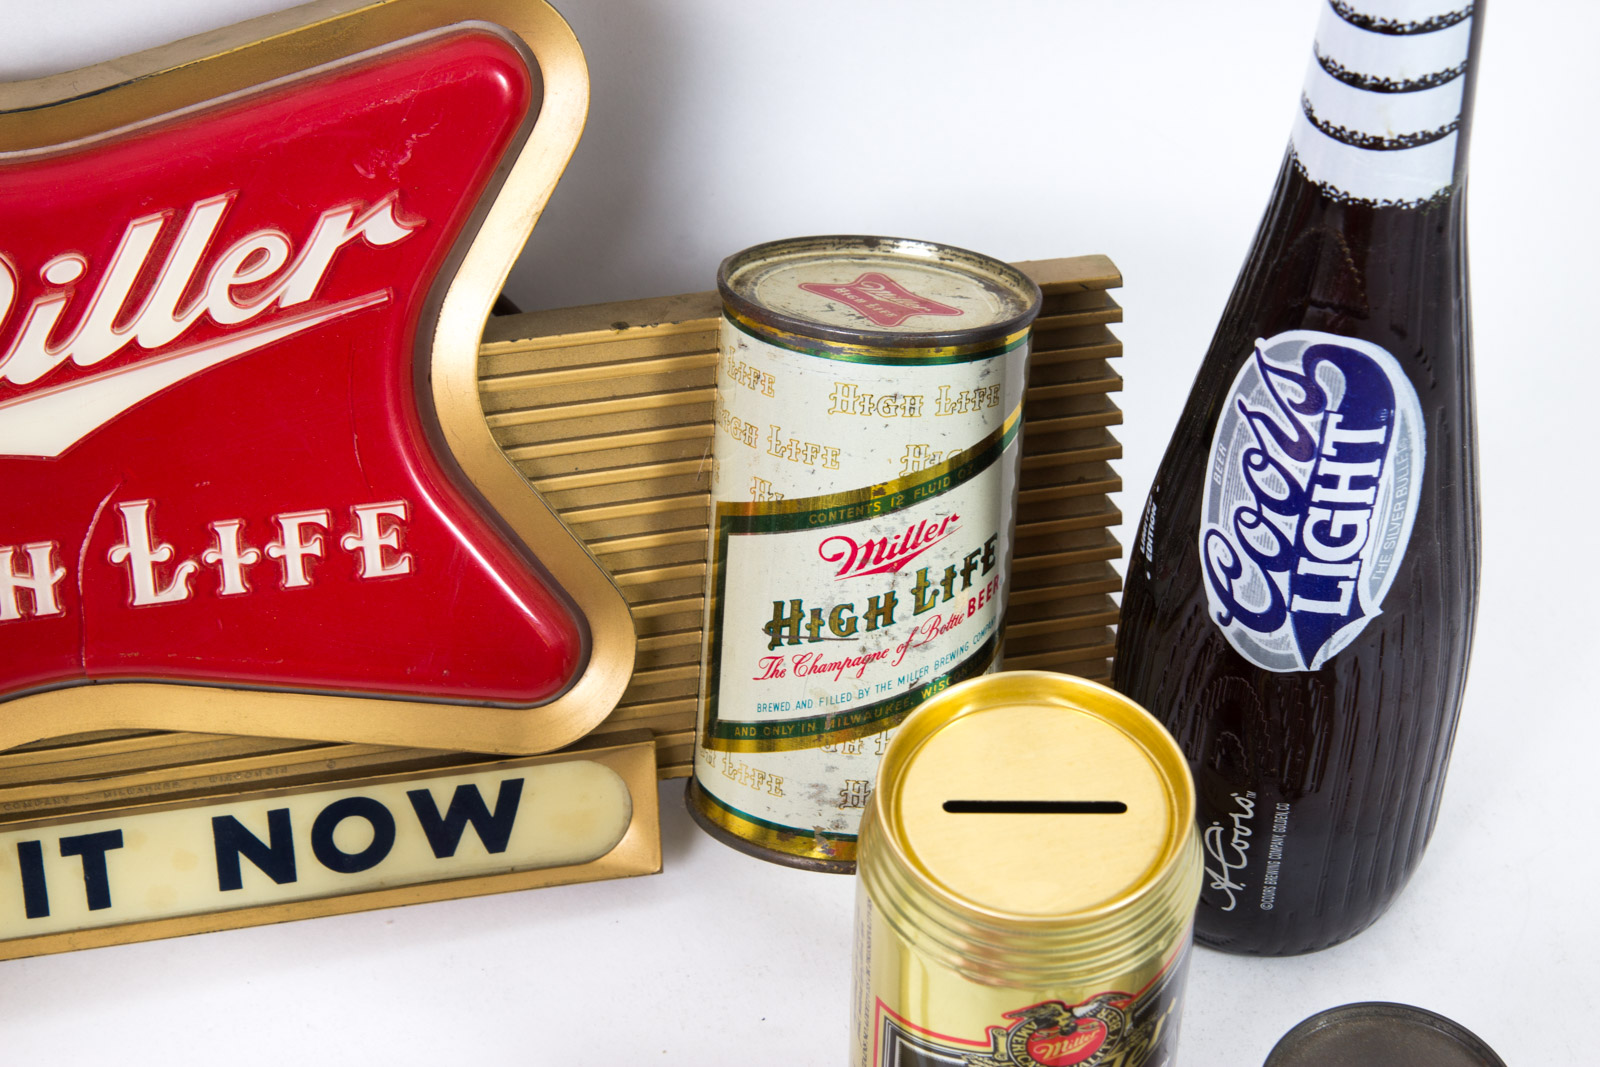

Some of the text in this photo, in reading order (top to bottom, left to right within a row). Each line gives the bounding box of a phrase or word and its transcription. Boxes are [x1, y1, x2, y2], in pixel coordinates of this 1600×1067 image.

[831, 286, 898, 318] HIGH LIFE
[856, 281, 931, 312] Miller
[727, 345, 776, 398] LIFE
[828, 382, 1000, 418] HIGH LIFE
[767, 424, 841, 471] LIFE
[1213, 443, 1227, 486] BEER
[809, 501, 882, 525] CONTENTS
[890, 494, 905, 508] 12
[913, 476, 951, 499] FLUID
[1203, 345, 1330, 633] Coors
[1290, 410, 1388, 616] LIGHT
[819, 512, 961, 577] Miller
[1140, 494, 1151, 554] LIMITED
[1146, 502, 1157, 562] EDITION
[1371, 553, 1392, 581] THE
[1384, 503, 1406, 551] SILVER
[107, 498, 414, 607] LIFE
[765, 533, 998, 651] HIGH LIFE
[752, 573, 999, 681] The Champagne of Bottle BEER
[757, 615, 997, 713] BREWED AND FILLED BY THE MILLER BREWING COMPANY
[734, 726, 757, 738] AND
[762, 724, 795, 737] ONLY
[801, 721, 816, 733] IN
[721, 752, 784, 797] LIFE
[1272, 811, 1290, 833] GOLDEN,
[1276, 802, 1291, 810] CO
[17, 778, 526, 919] IT NOW
[1268, 834, 1288, 860] COMPANY,
[1264, 860, 1281, 885] BREWING
[1096, 1008, 1121, 1032] BEER
[1033, 1029, 1100, 1060] Miller
